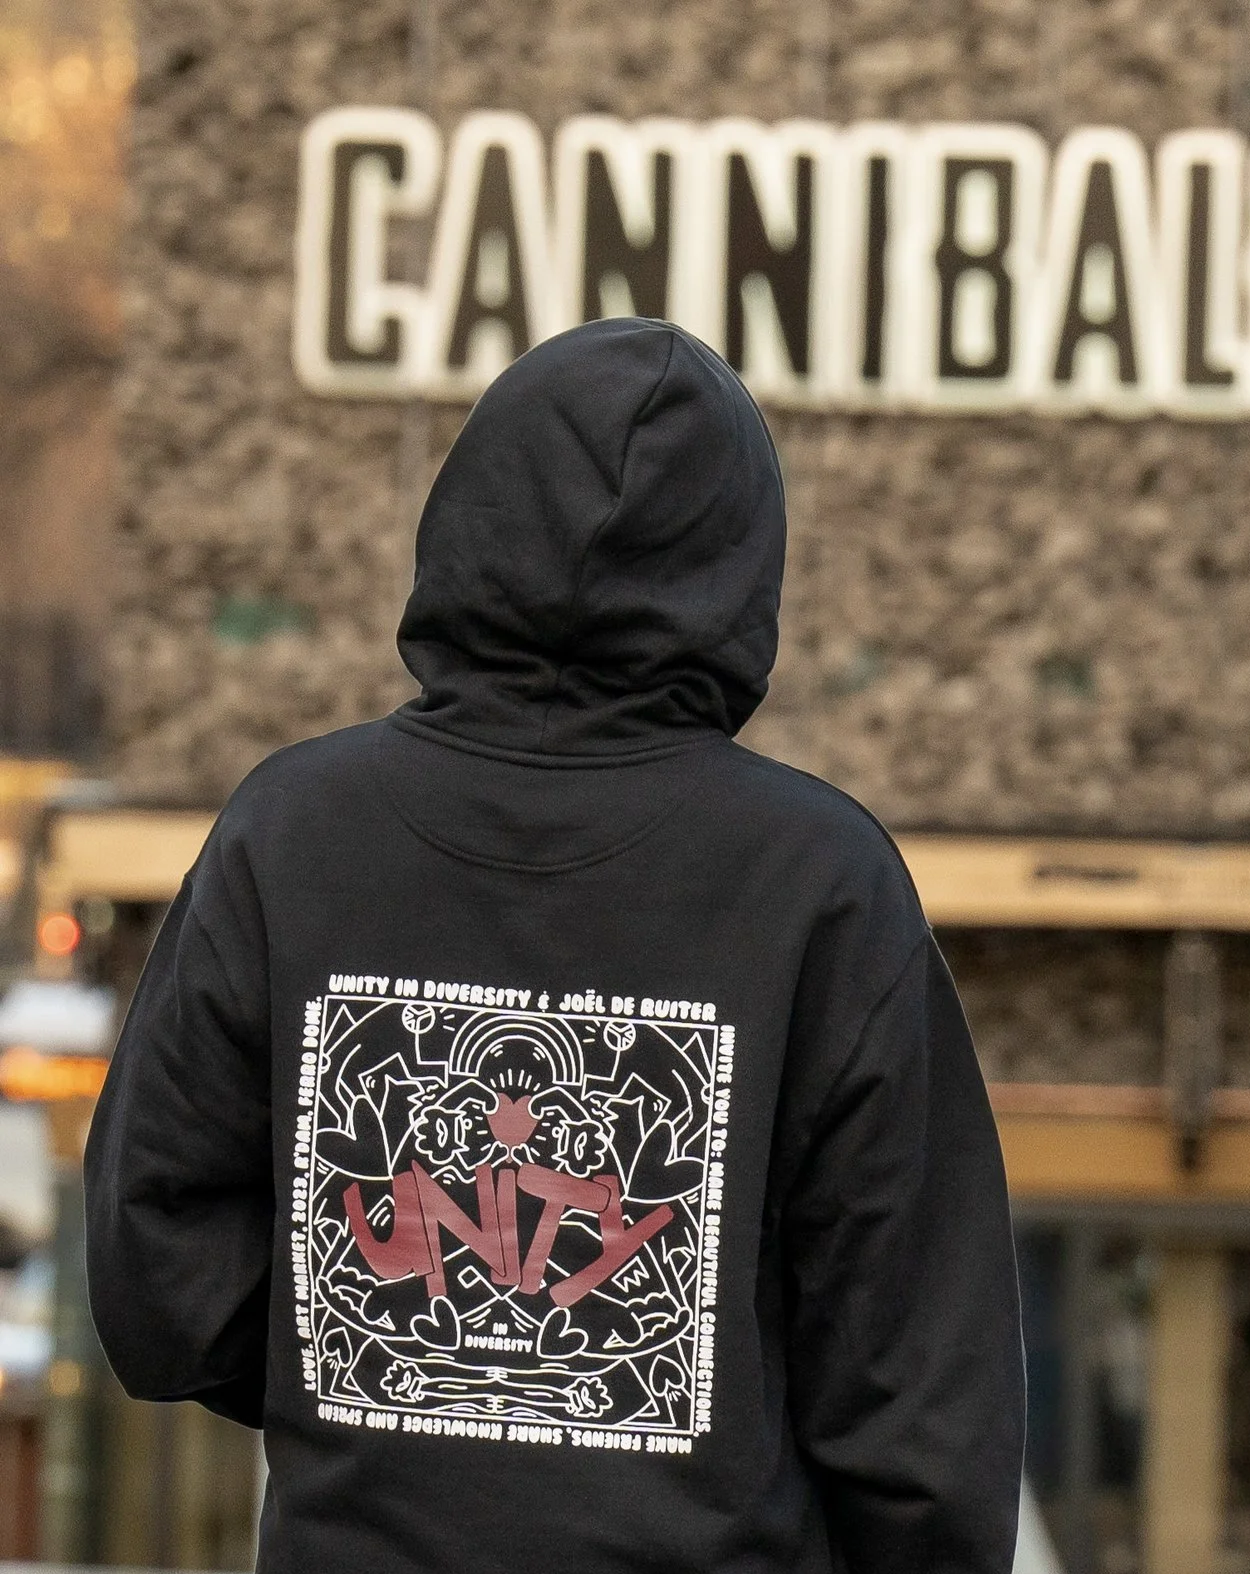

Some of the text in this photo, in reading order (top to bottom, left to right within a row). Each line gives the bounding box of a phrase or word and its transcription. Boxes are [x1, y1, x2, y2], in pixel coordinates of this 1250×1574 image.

[329, 974, 390, 995] UNITY
[395, 978, 419, 998] IN
[424, 981, 532, 1009] DIVERSITY
[559, 989, 605, 1014] JOËL
[611, 996, 635, 1016] DE
[640, 998, 718, 1022] RUITER
[715, 1024, 736, 1084] INVITE
[297, 1052, 318, 1106] FERRO
[712, 1088, 731, 1124] YOU
[710, 1128, 728, 1158] TO:
[706, 1161, 725, 1211] MAKE
[343, 1159, 674, 1307] UNITY
[700, 1214, 721, 1308] BEAUTIFUL
[295, 1304, 312, 1339] ART
[491, 1322, 509, 1335] IN
[465, 1335, 533, 1353] DIVERSITY
[317, 1402, 362, 1426] SPREAD
[366, 1413, 398, 1431] AND
[402, 1415, 502, 1441] KNOWLEDGE
[506, 1423, 562, 1445] SHARE
[645, 1434, 692, 1454] MAKE
